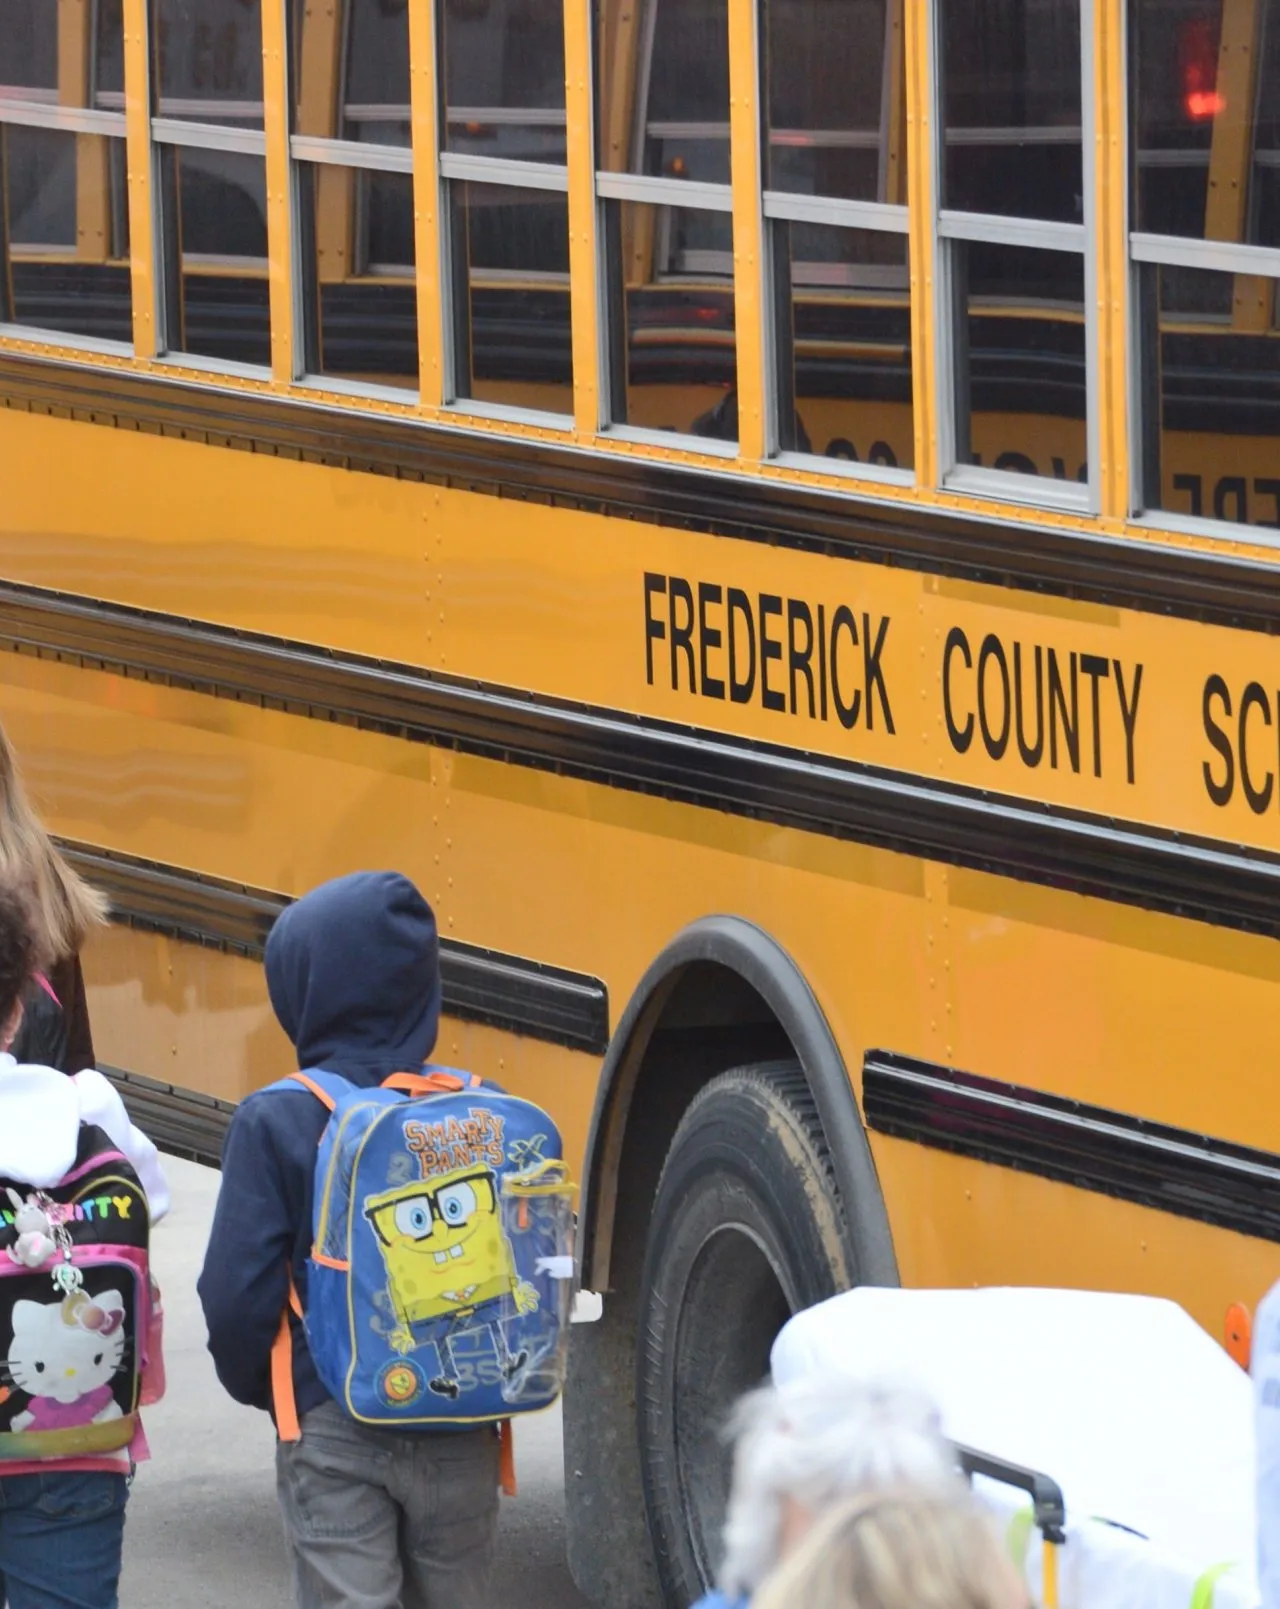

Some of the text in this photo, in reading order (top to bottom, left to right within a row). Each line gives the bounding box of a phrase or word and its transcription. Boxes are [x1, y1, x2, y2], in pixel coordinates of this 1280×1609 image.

[643, 571, 1280, 816] FREDERICK COUNTY SC
[405, 1109, 504, 1152] SMARTY
[419, 1141, 504, 1179] PANTS
